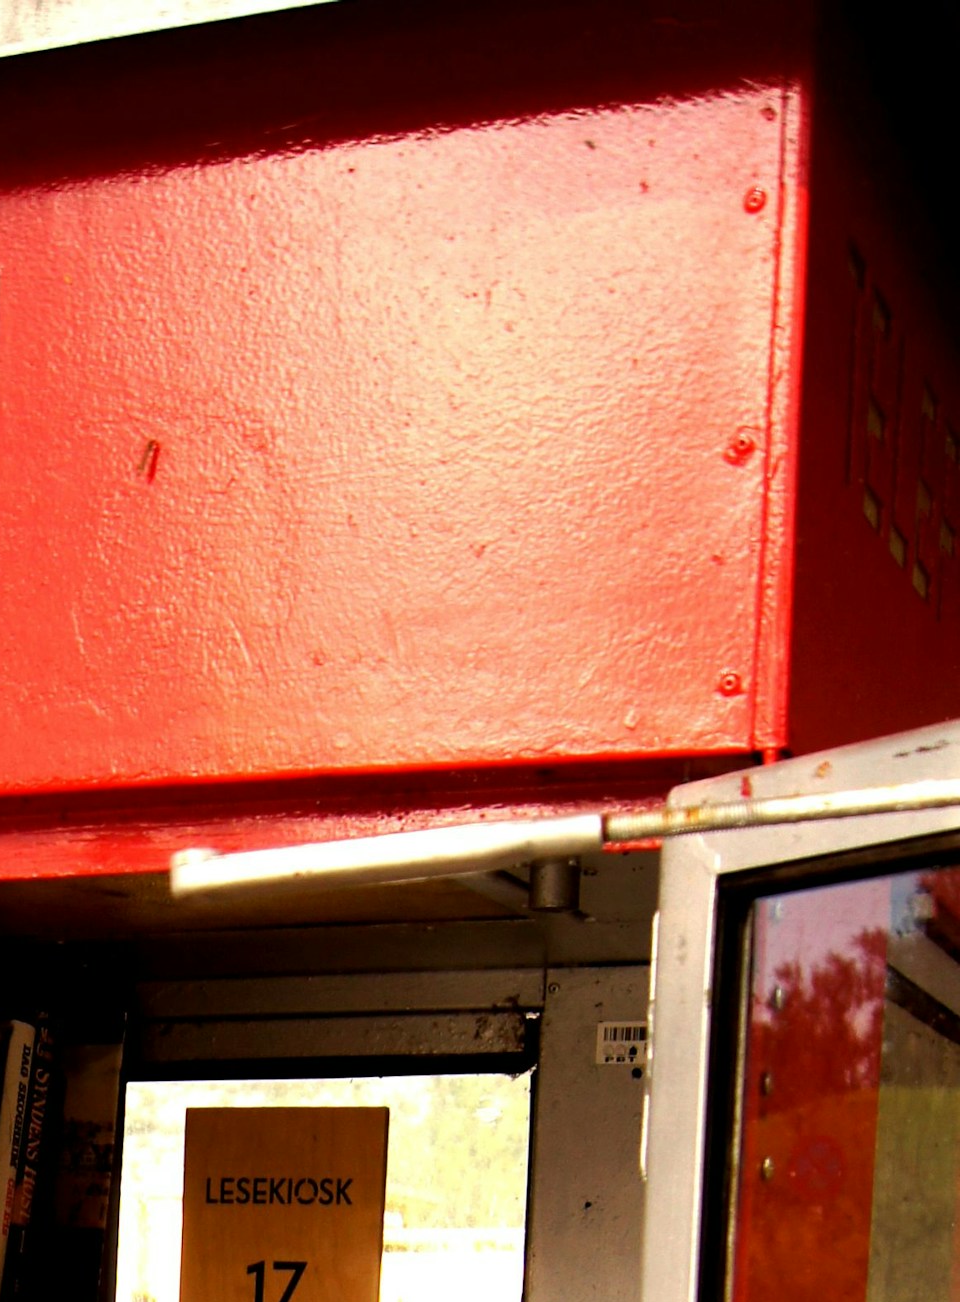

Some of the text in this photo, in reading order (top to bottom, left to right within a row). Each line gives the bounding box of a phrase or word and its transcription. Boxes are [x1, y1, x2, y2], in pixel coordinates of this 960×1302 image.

[23, 1044, 32, 1072] DAG
[25, 1067, 52, 1160] SYNDENS
[205, 1177, 353, 1205] LESEKIOSK
